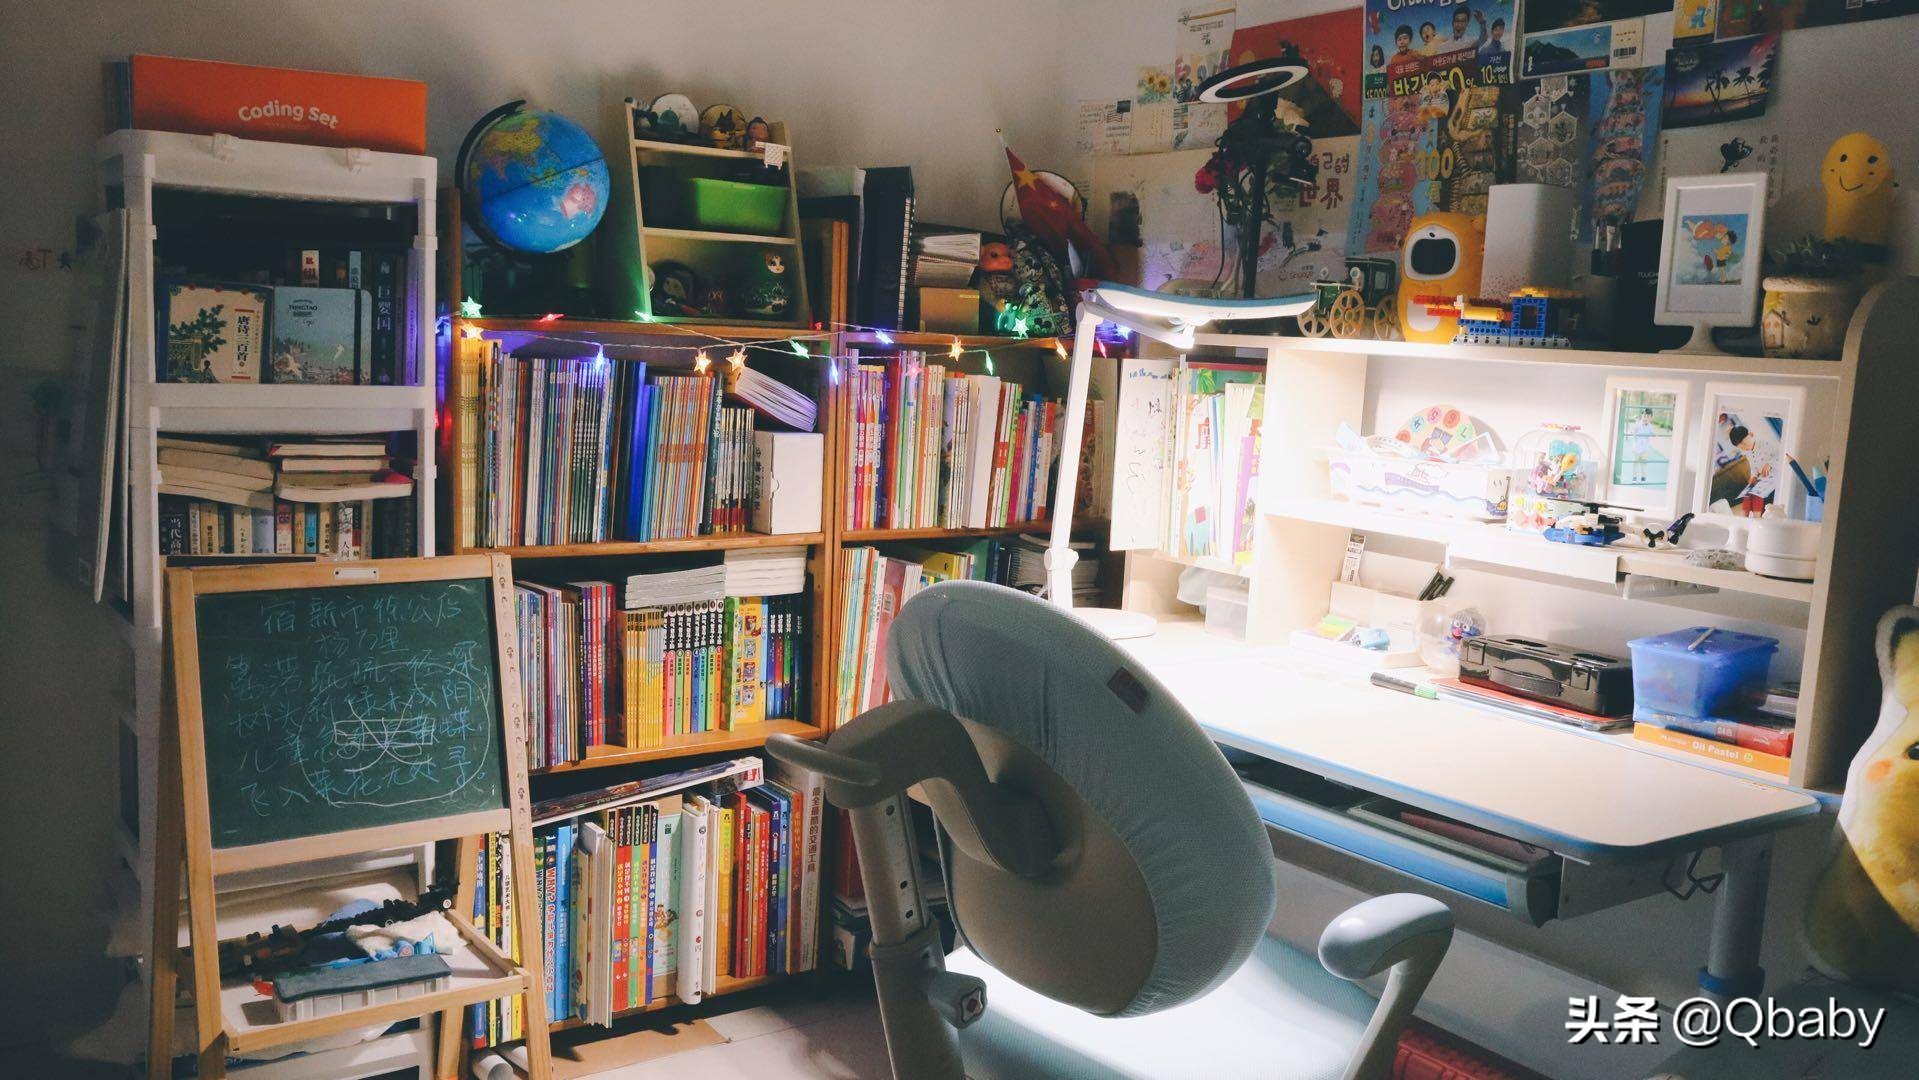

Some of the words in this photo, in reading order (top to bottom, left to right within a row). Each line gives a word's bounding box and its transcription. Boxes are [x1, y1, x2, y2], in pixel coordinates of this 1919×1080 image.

[238, 99, 304, 121] Coding
[308, 106, 339, 129] Set
[237, 315, 250, 362] 唐诗三百首
[1691, 741, 1706, 752] Oil
[1708, 744, 1739, 759] Pastel
[545, 867, 557, 902] WHY?
